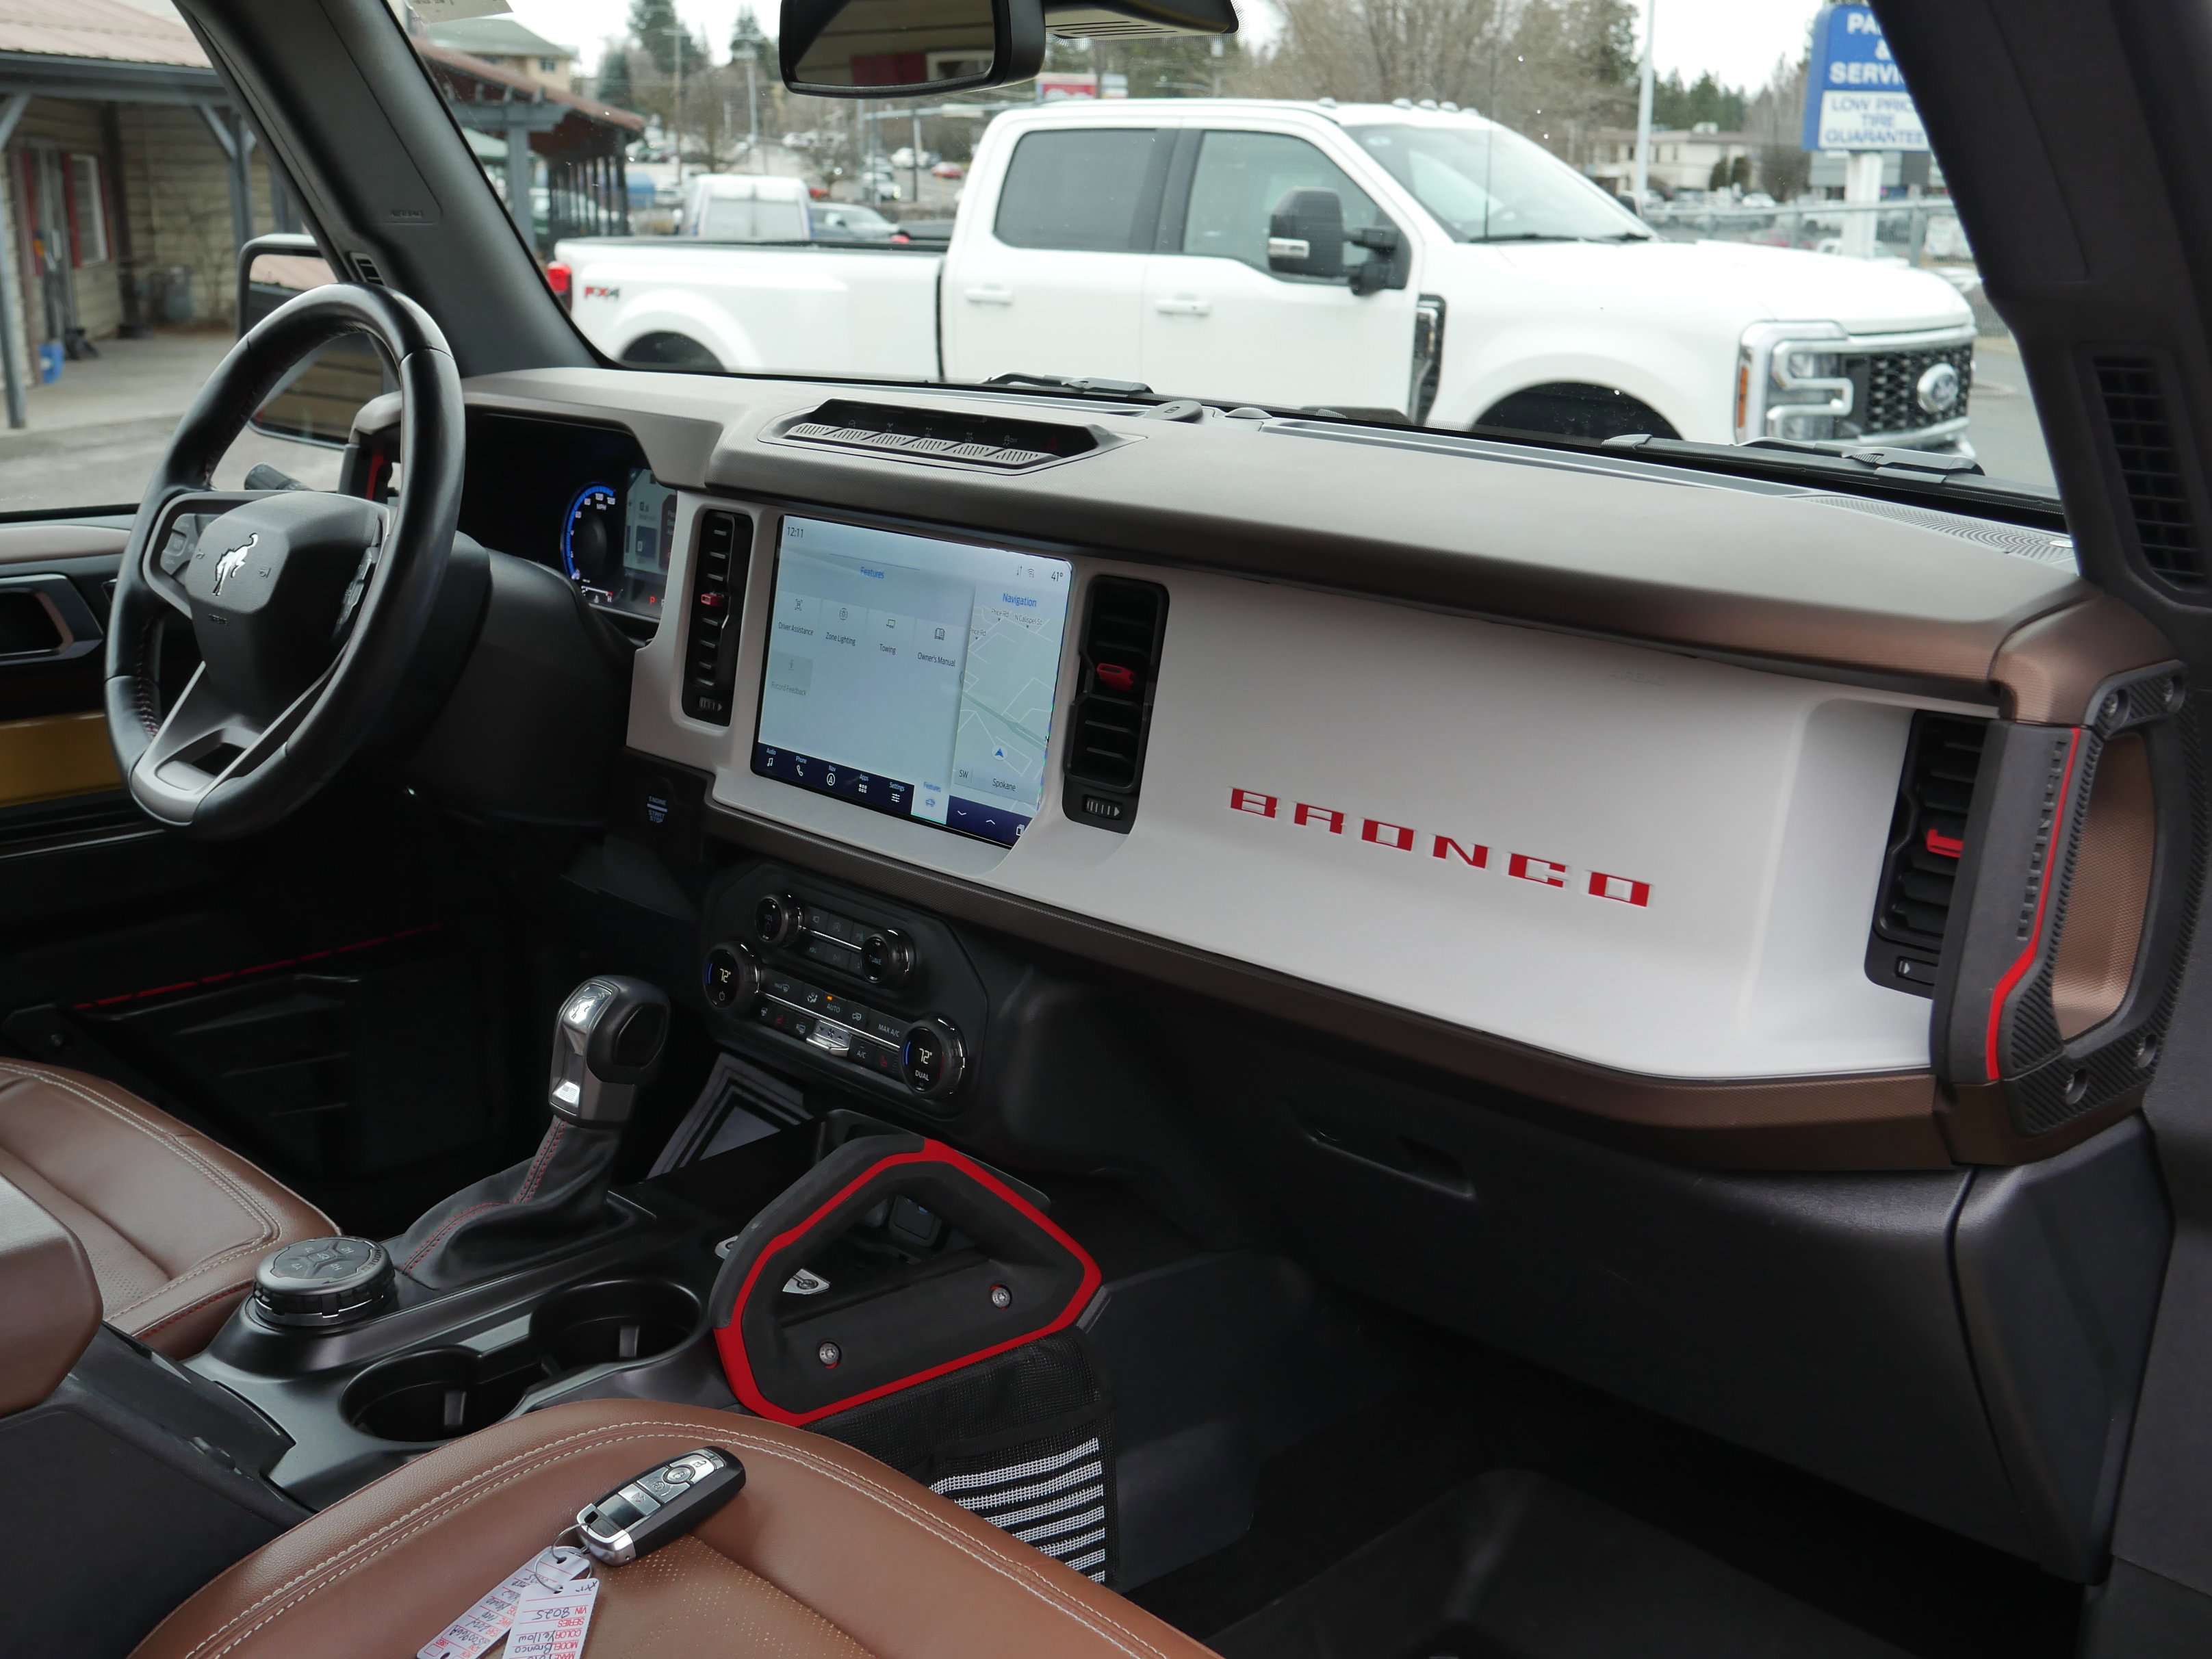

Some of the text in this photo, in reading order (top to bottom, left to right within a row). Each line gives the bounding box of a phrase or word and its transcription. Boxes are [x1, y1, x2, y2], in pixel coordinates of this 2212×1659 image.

[1847, 12, 1881, 34] PA
[1875, 39, 1892, 60] &
[1829, 62, 1905, 84] SERVI
[1831, 98, 1869, 112] LOW
[1861, 114, 1895, 127] TIRE
[584, 286, 619, 300] FX4
[787, 526, 803, 538] 12:11
[860, 567, 885, 579] Features
[1051, 571, 1064, 582] 41°
[1003, 593, 1037, 608] Navigation
[991, 608, 1003, 617] Price
[778, 621, 814, 636] Driver Assistance
[825, 632, 856, 646] Zone Lighting
[879, 643, 897, 655] Towing
[918, 652, 956, 667] Owner's Manual
[766, 747, 777, 756] Audio
[795, 756, 807, 764] Phone
[859, 773, 869, 782] Apps
[959, 769, 969, 780] SW
[889, 782, 905, 793] Settings
[923, 781, 942, 793] Features
[992, 778, 1016, 793] Spokane
[1230, 786, 1651, 908] BRONCO
[869, 954, 882, 966] TUNE
[826, 1003, 840, 1014] AUTO
[878, 1023, 900, 1038] MAX A/C
[856, 1050, 867, 1059] A/C
[915, 1069, 929, 1081] DUAL
[361, 1247, 382, 1272] MODES
[532, 1606, 587, 1621] VIN 8025
[557, 1618, 584, 1628] SERIES
[518, 1630, 582, 1643] COLOR Yellow
[515, 1641, 579, 1654] MODEL Bronco
